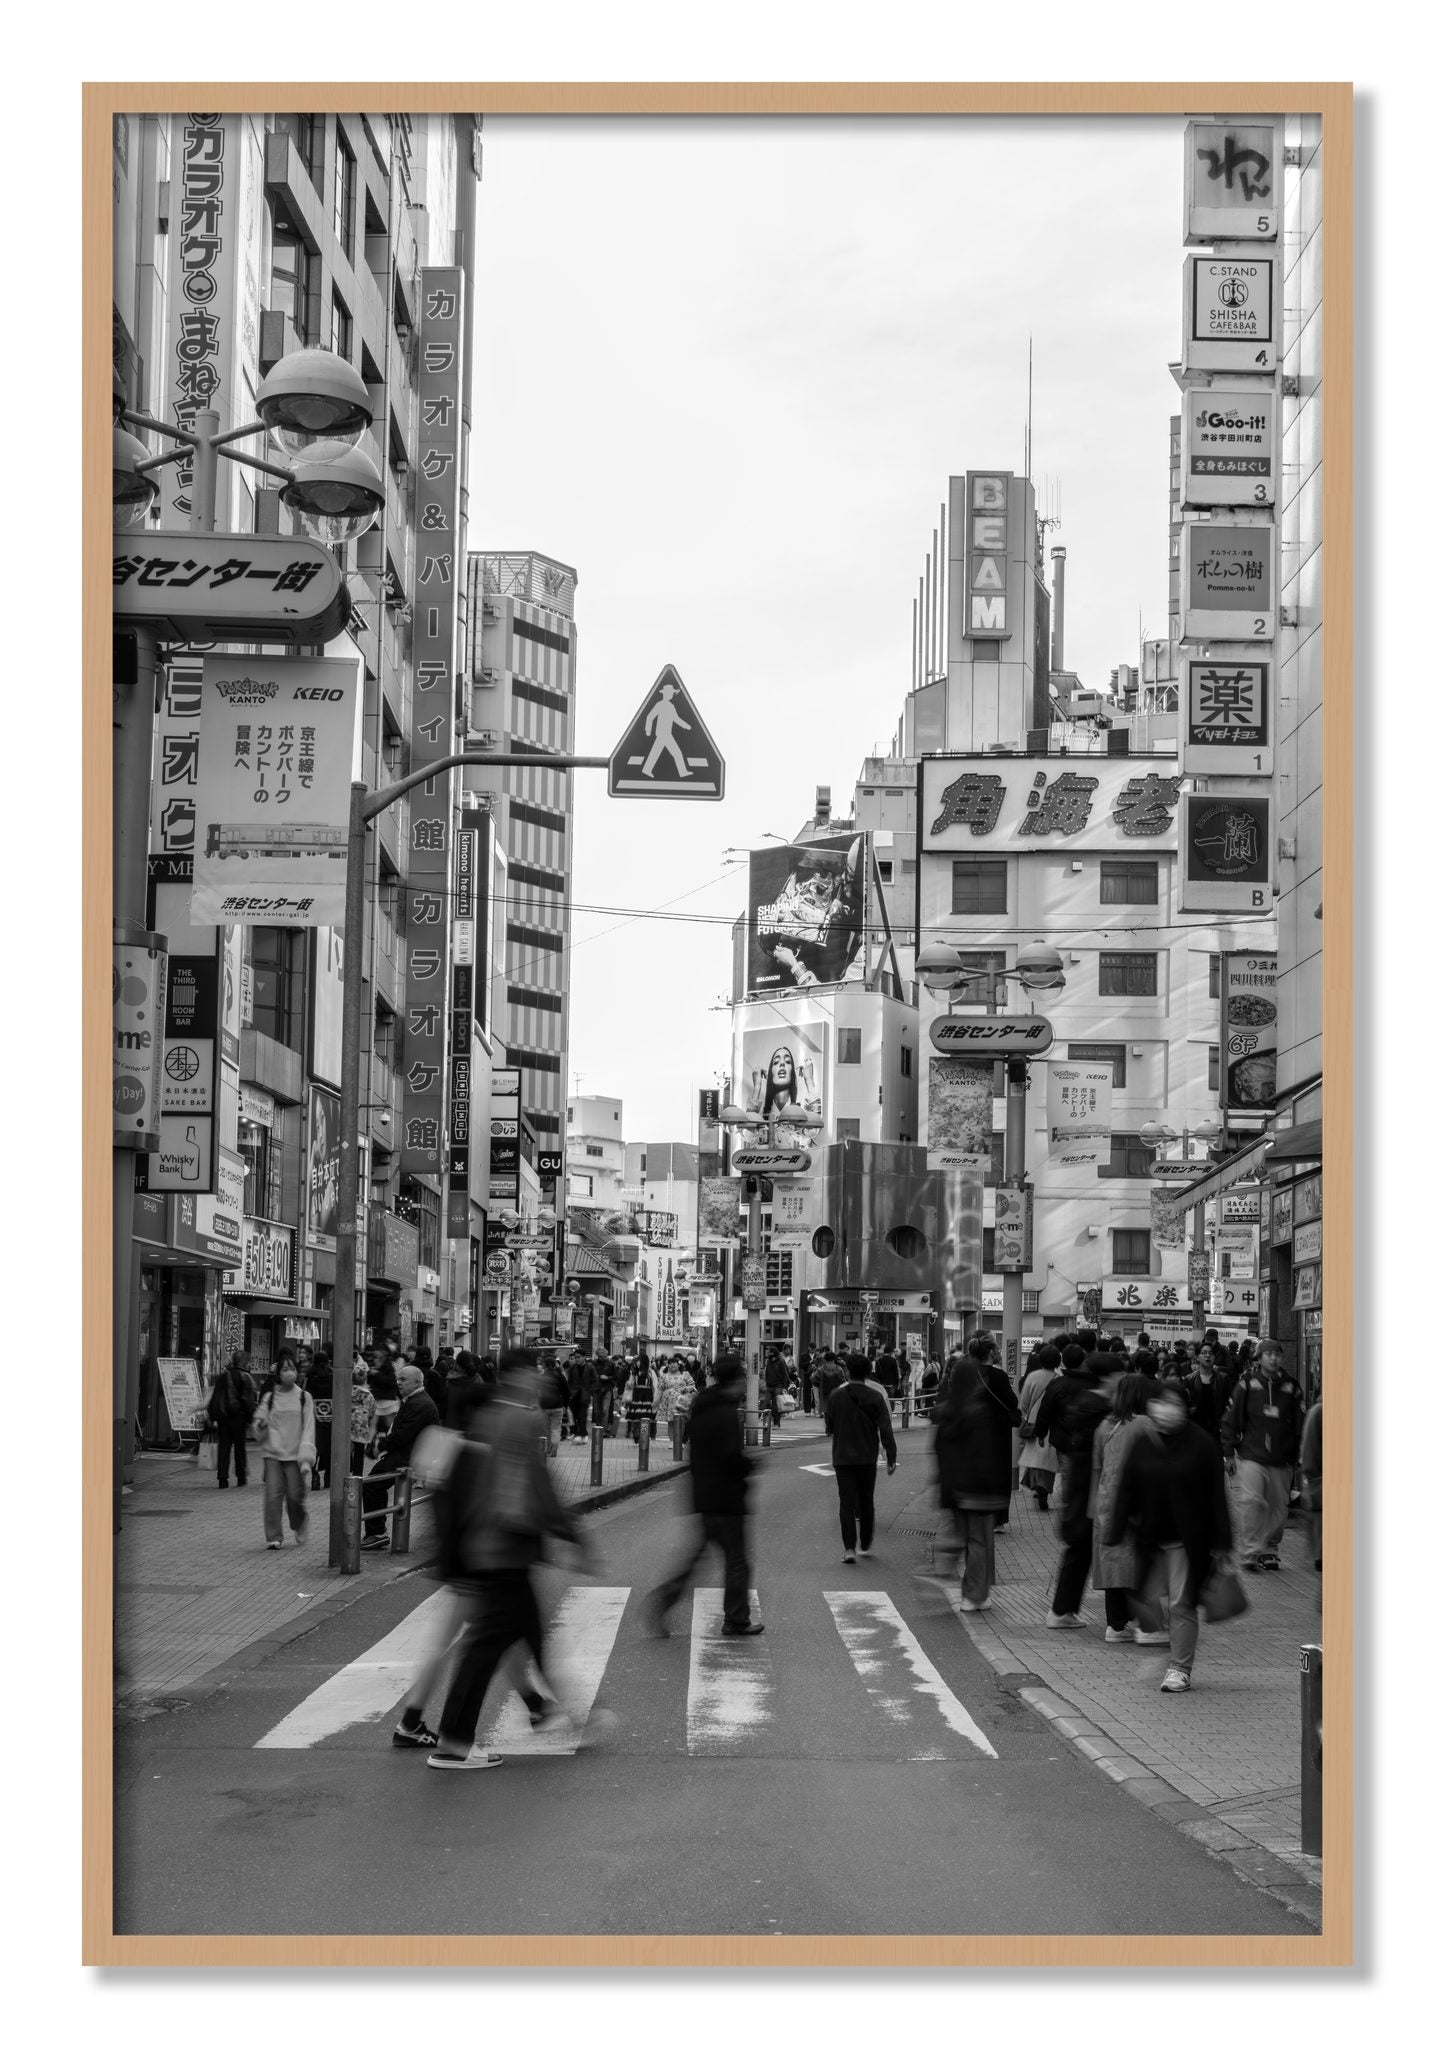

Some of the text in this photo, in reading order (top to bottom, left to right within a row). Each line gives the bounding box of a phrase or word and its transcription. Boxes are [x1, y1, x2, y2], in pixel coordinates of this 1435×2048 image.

[181, 127, 224, 272] カラオケ
[1257, 217, 1270, 232] 5
[1209, 266, 1258, 277] C.STAND
[1209, 310, 1257, 321] SHISHA
[1209, 321, 1257, 331] CAFE&BAR
[1255, 349, 1268, 366] 4
[1208, 412, 1266, 429] Goo-it!
[1195, 460, 1267, 473] 全身もみほぐし
[1254, 484, 1267, 501] 3
[972, 476, 1006, 630] BEAM
[1196, 559, 1264, 580] ポムの樹
[1207, 584, 1255, 592] Pomme-no-ki
[1253, 618, 1266, 635] 2
[229, 696, 266, 704] KANTO
[292, 687, 344, 702] KEIO
[1200, 670, 1253, 724] 薬
[1193, 726, 1259, 741] マツモトキヨシ
[234, 725, 252, 770] 冒険へ
[253, 726, 273, 804] カントーの
[275, 725, 295, 804] ポケパーク
[297, 727, 316, 789] 京王線で
[1253, 755, 1263, 770] 1
[931, 772, 1182, 838] 角海老
[1193, 812, 1260, 866] 一蘭
[461, 834, 470, 873] kimono
[220, 897, 315, 912] 渋谷センター街
[1253, 890, 1264, 906] B
[1230, 974, 1276, 986] 四川料理
[176, 1018, 191, 1026] BAR
[938, 1025, 1046, 1038] 渋谷センター街
[1228, 1035, 1258, 1055] 6F
[504, 1127, 516, 1135] UP
[160, 1155, 194, 1166] Whisky
[540, 1158, 560, 1169] GU
[736, 1156, 799, 1164] 渋谷センター街
[160, 1165, 180, 1173] Bank
[664, 1282, 674, 1327] BEER
